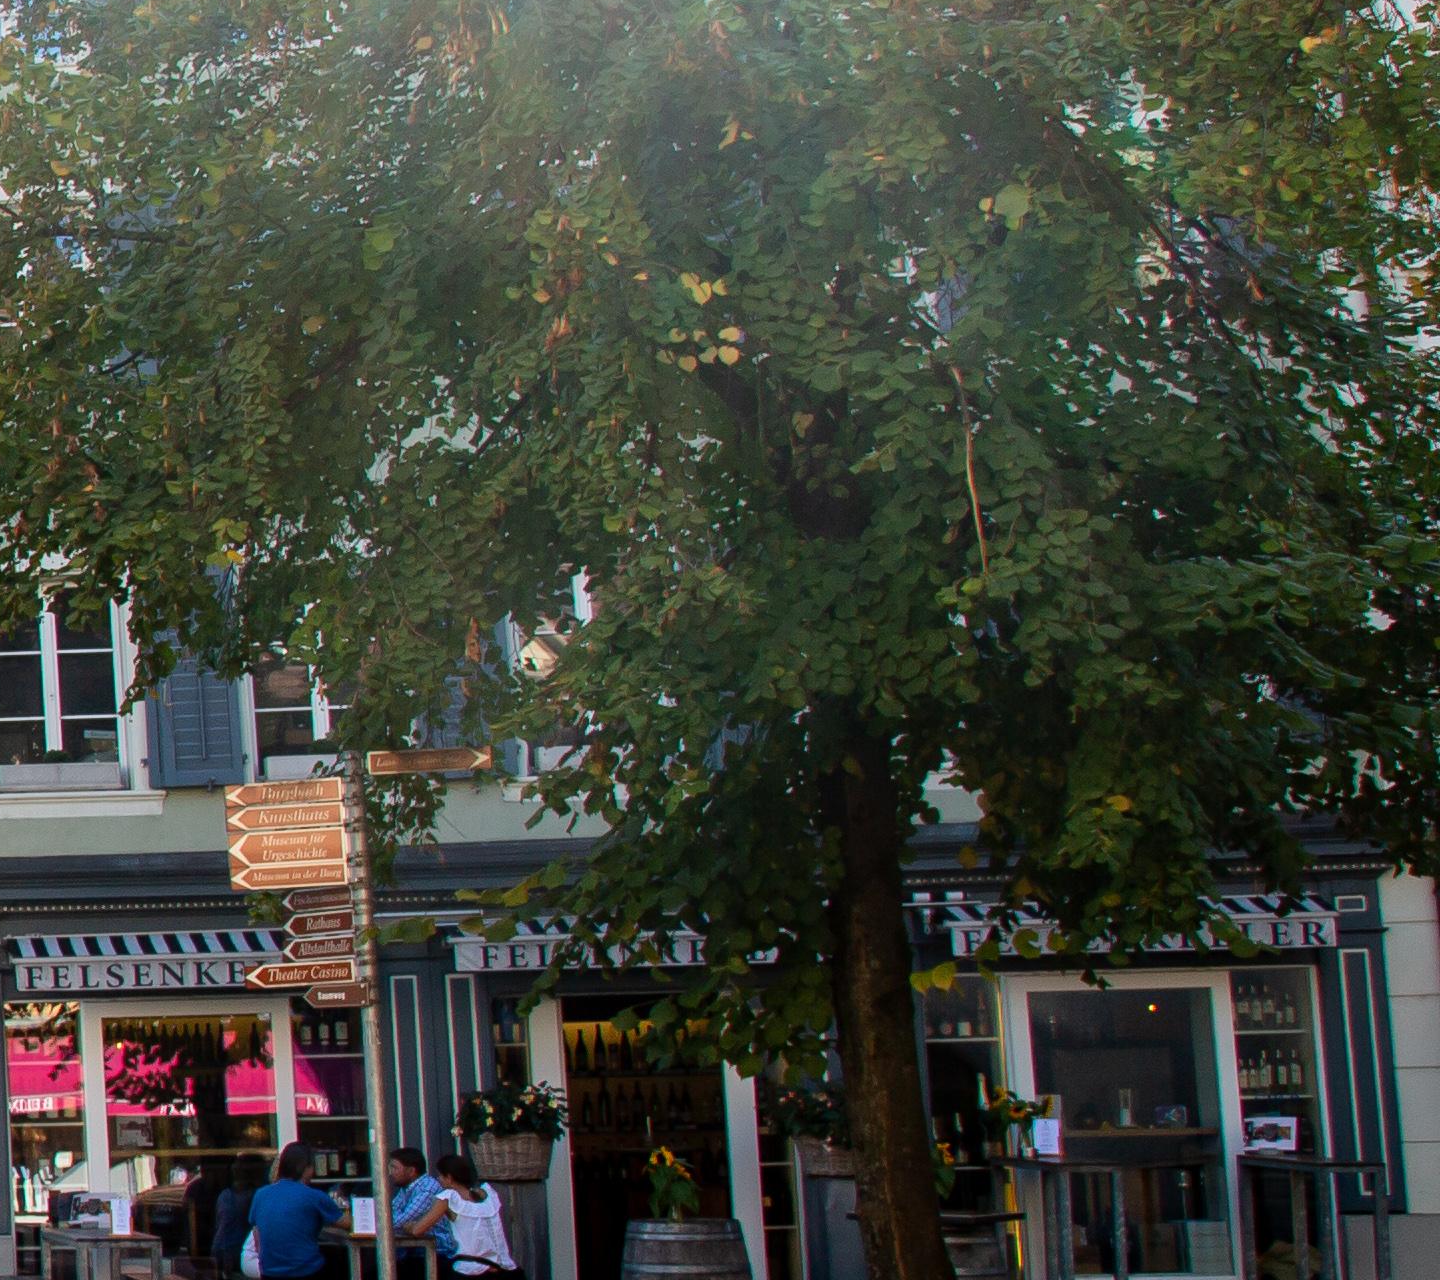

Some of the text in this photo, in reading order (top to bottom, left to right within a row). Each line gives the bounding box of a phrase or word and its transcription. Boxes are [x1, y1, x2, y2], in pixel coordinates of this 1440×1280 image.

[261, 783, 324, 802] Burgbach
[258, 808, 330, 825] Kunsthaus
[261, 835, 307, 847] Museum
[262, 849, 328, 862] Urgeschichte
[252, 867, 342, 881] Museum in der Burg
[306, 917, 341, 931] Rathaus
[298, 940, 350, 956] Altstadthalle
[268, 964, 349, 982] Theater Casino
